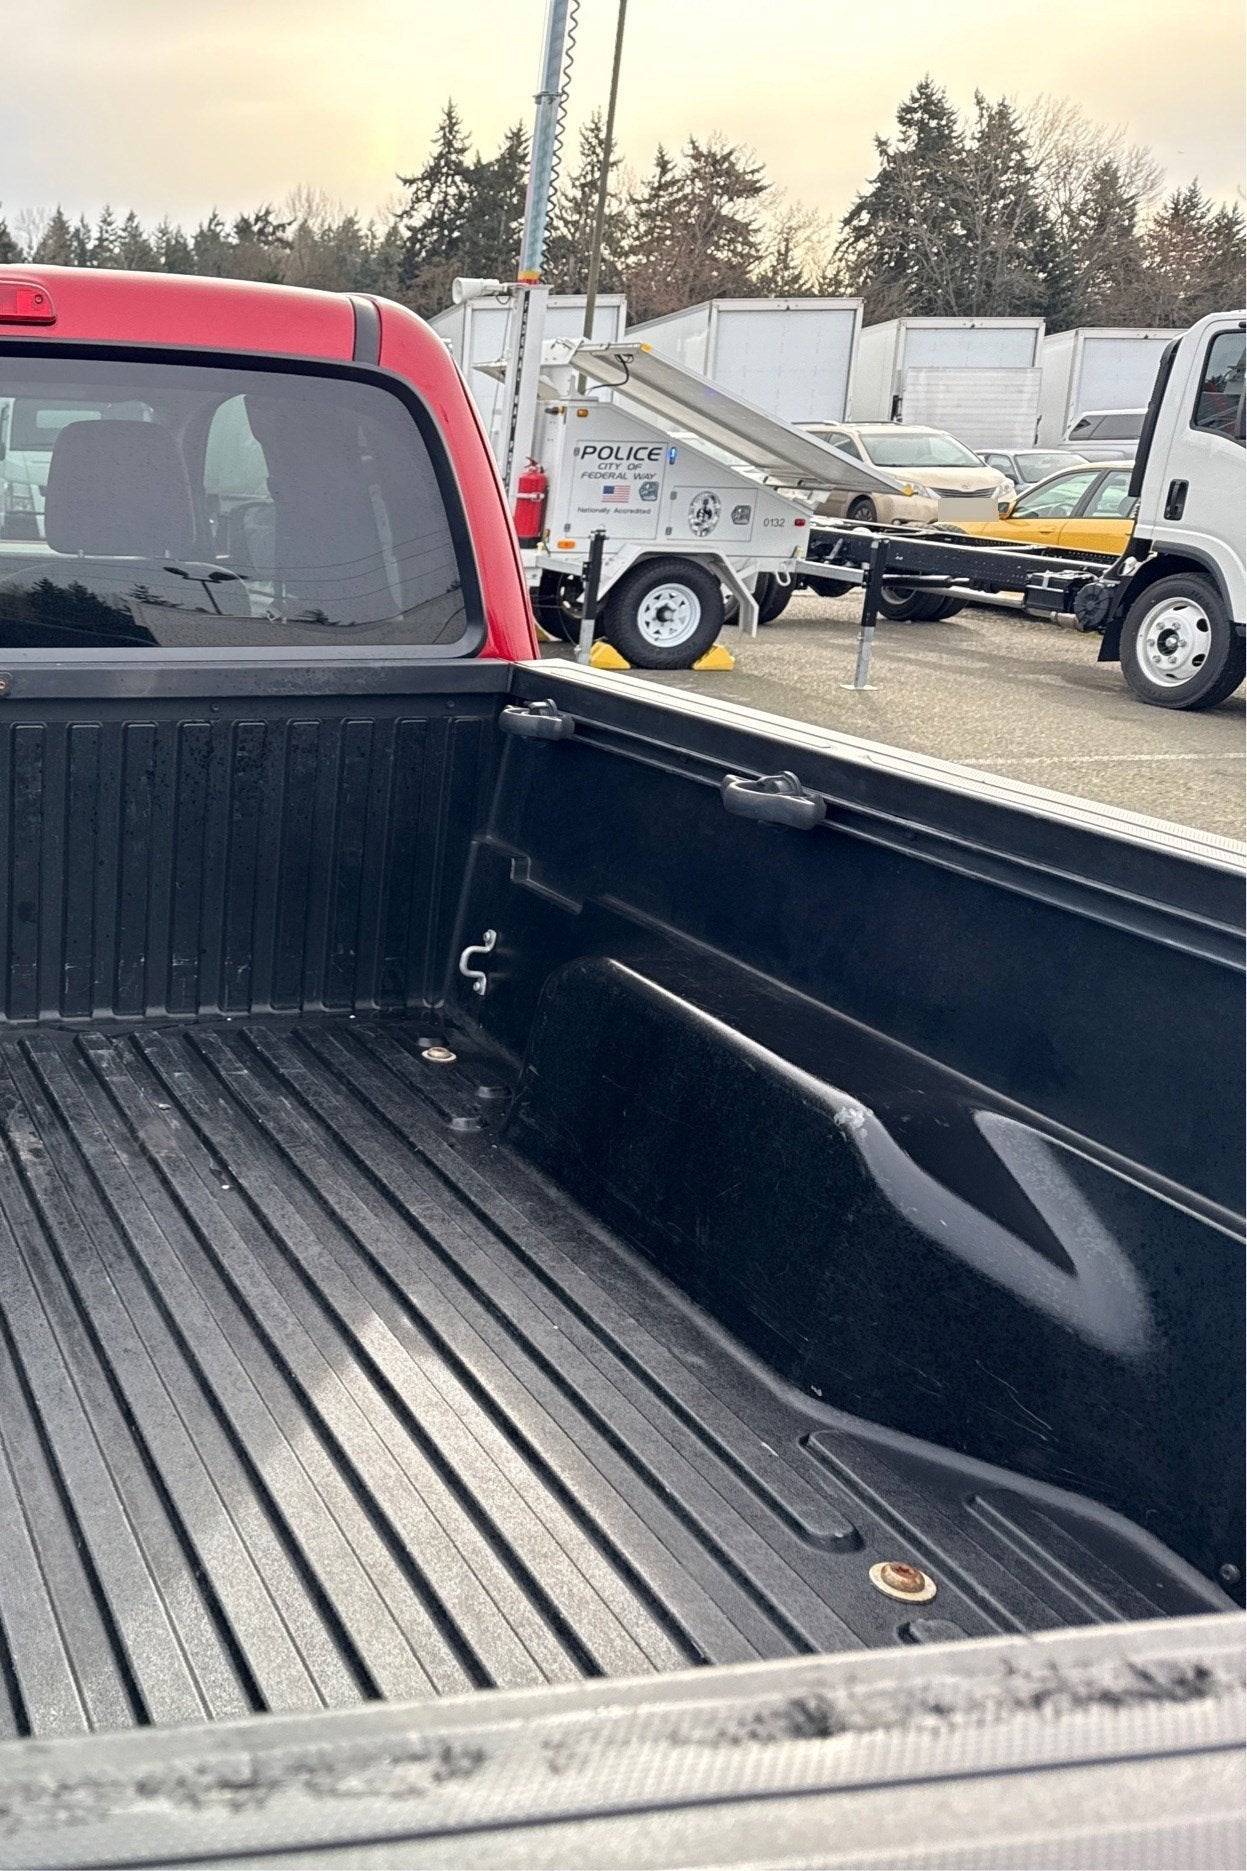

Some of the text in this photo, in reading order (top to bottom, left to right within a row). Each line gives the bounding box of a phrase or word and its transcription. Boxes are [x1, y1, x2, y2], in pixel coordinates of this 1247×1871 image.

[580, 445, 663, 461] POLICE
[597, 462, 643, 471] CITY OF
[580, 471, 656, 480] FEDERAL WAY
[613, 507, 651, 515] Accredited
[763, 518, 786, 528] 0132
